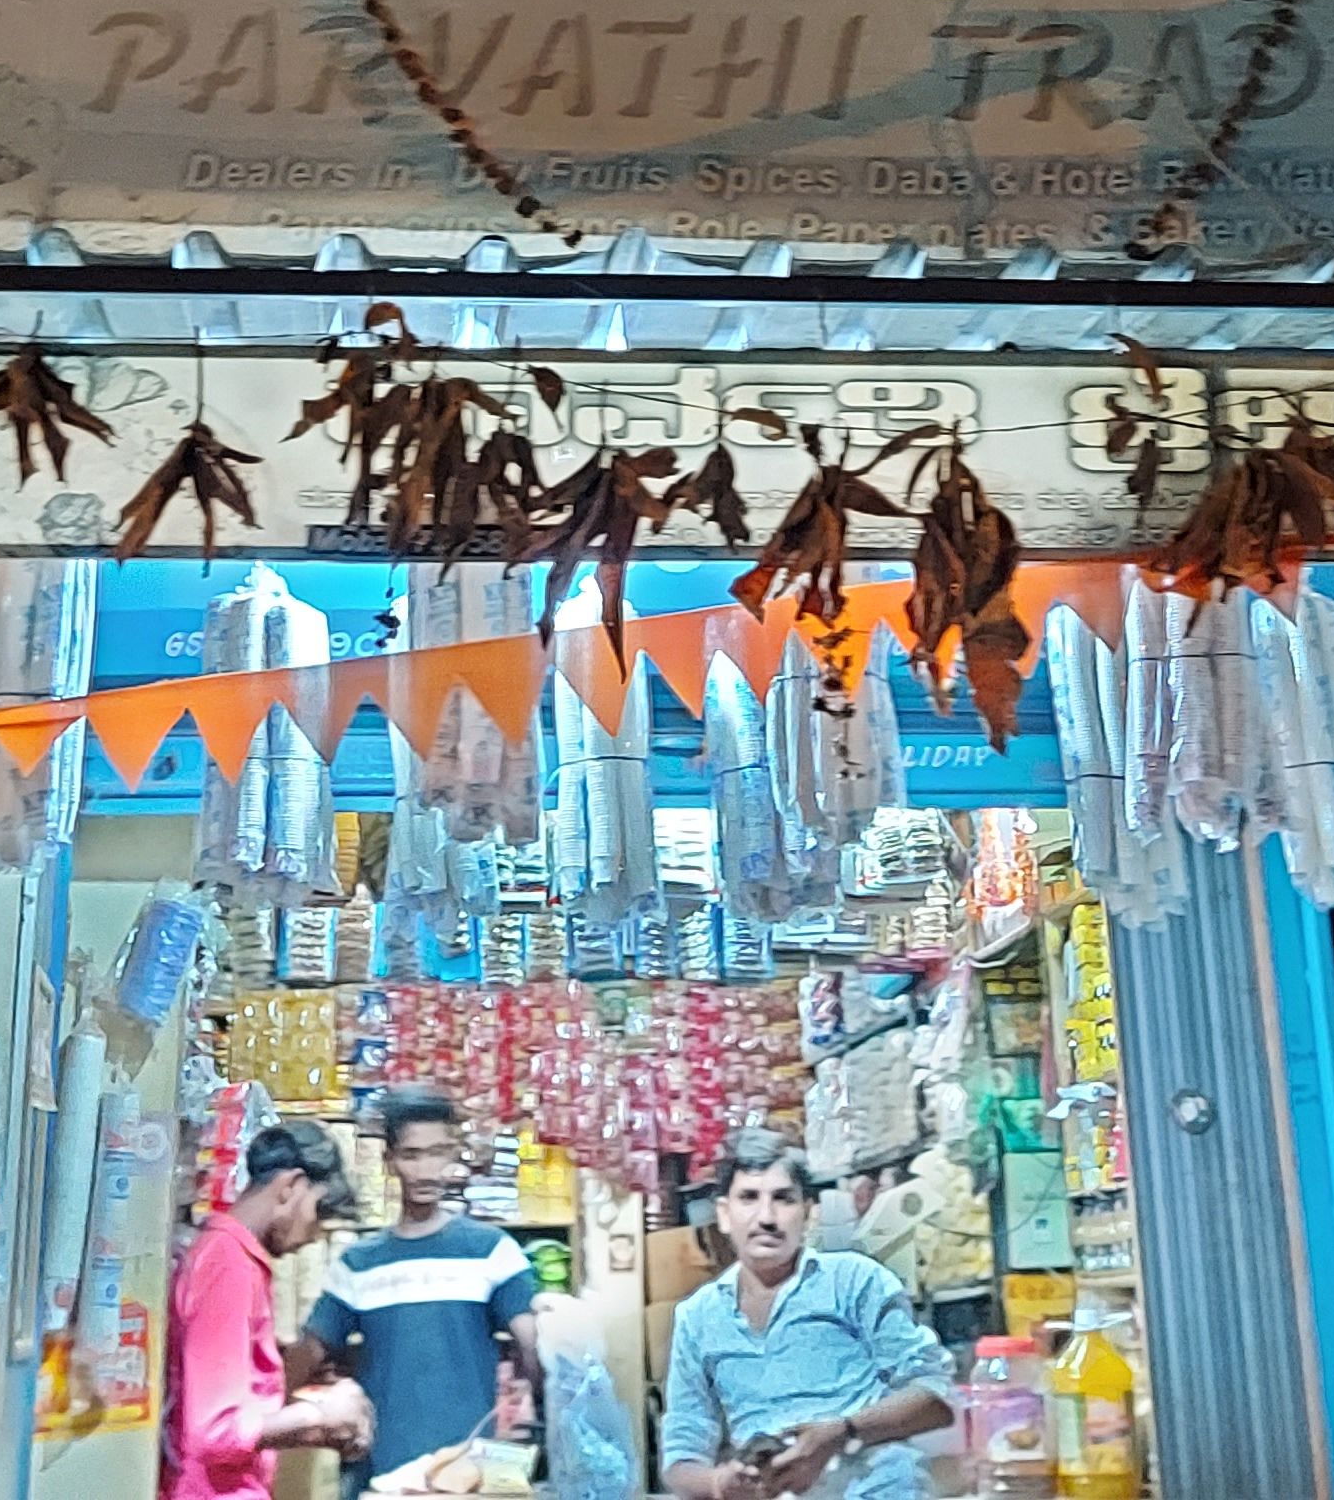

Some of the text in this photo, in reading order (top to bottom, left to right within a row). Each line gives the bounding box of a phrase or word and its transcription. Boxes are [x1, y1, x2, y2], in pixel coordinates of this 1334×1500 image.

[84, 10, 866, 119] PARVATHI
[186, 154, 356, 192] Dealers
[867, 162, 971, 198] Daba
[992, 163, 1021, 197] &
